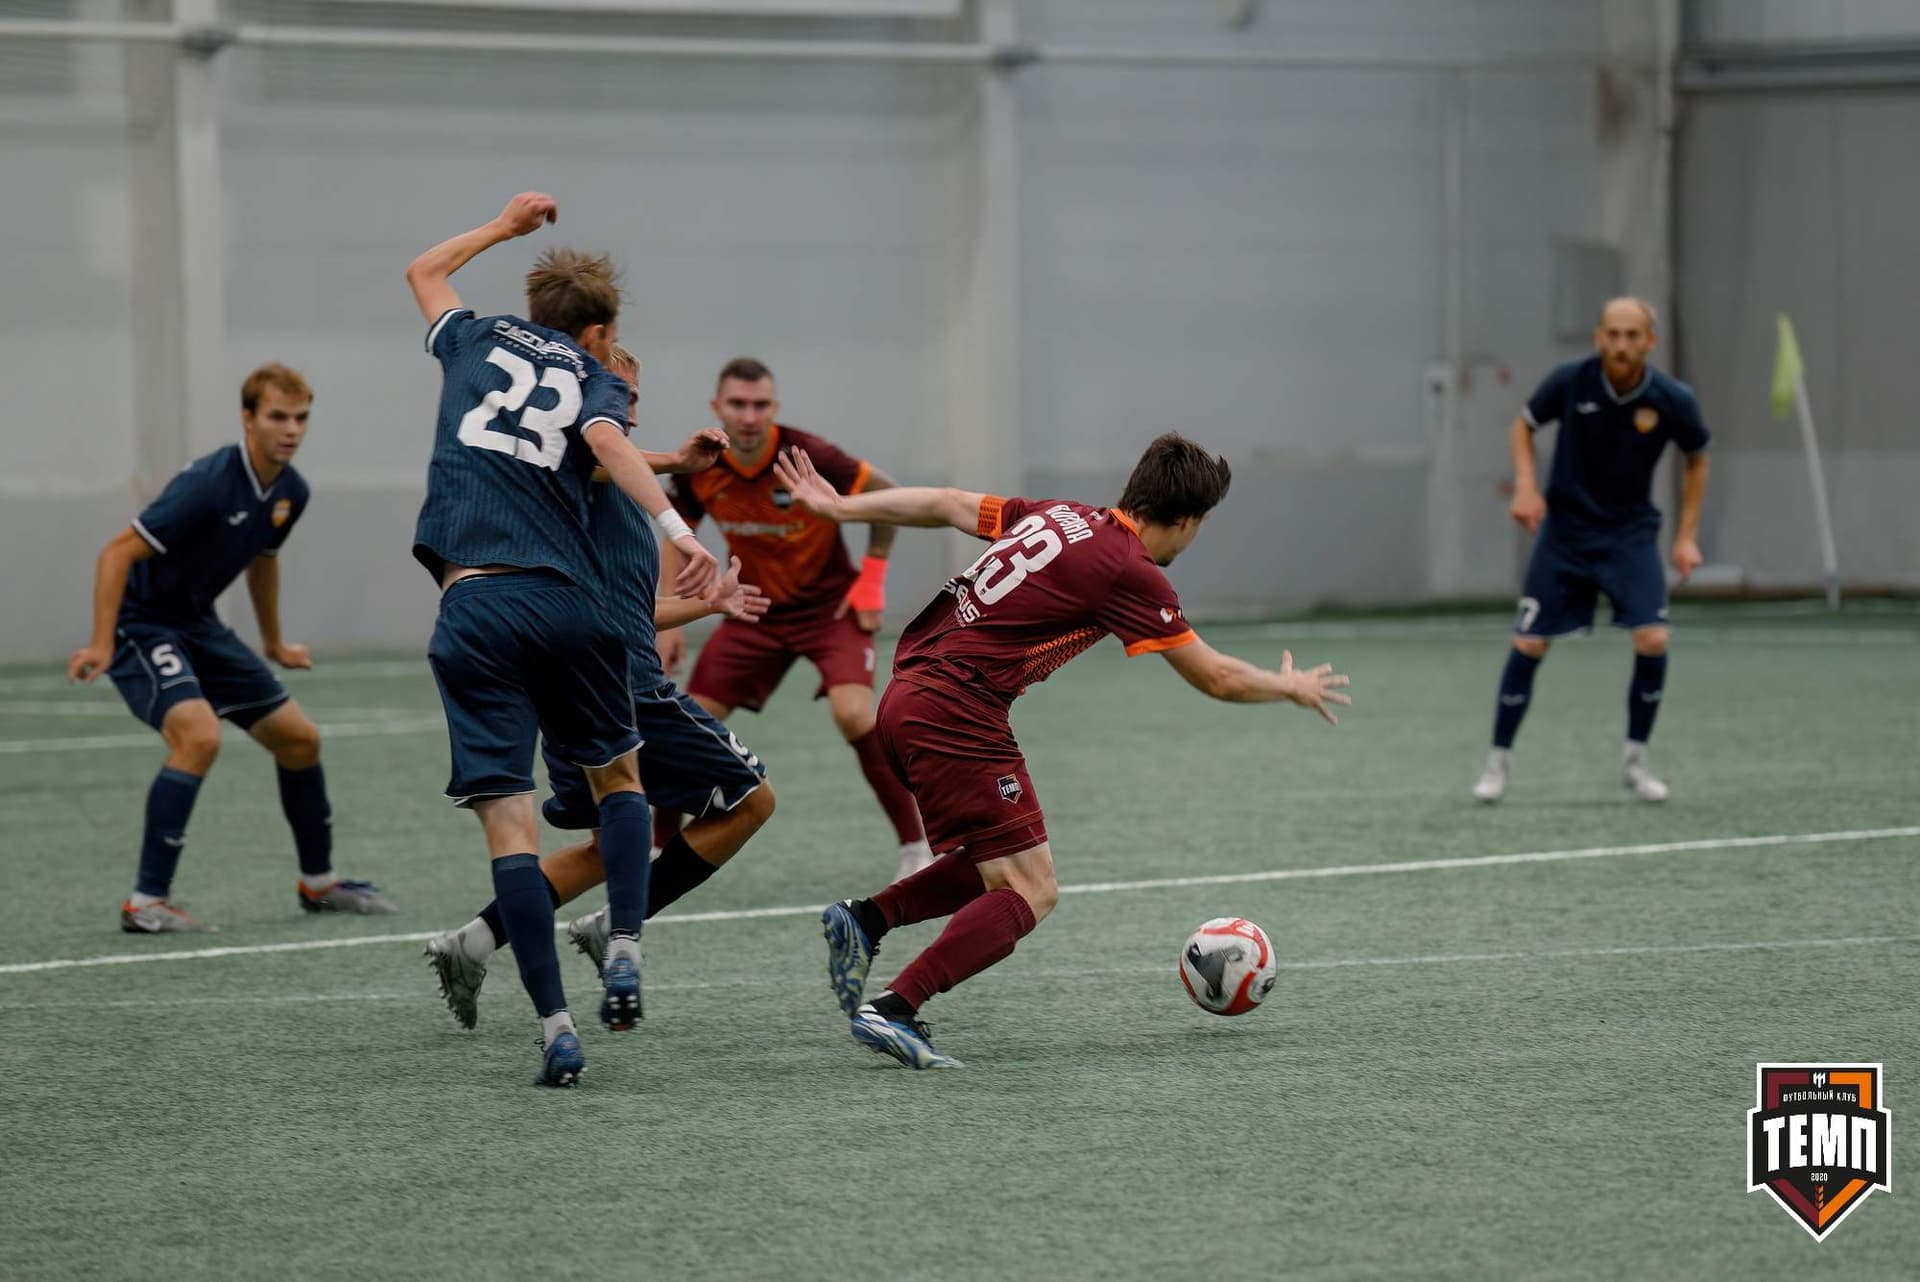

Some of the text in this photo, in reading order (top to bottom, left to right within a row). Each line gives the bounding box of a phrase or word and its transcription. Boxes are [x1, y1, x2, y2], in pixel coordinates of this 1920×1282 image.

[457, 346, 583, 472] 23
[962, 515, 1063, 606] 23
[1518, 597, 1541, 633] 7
[151, 643, 183, 677] 5
